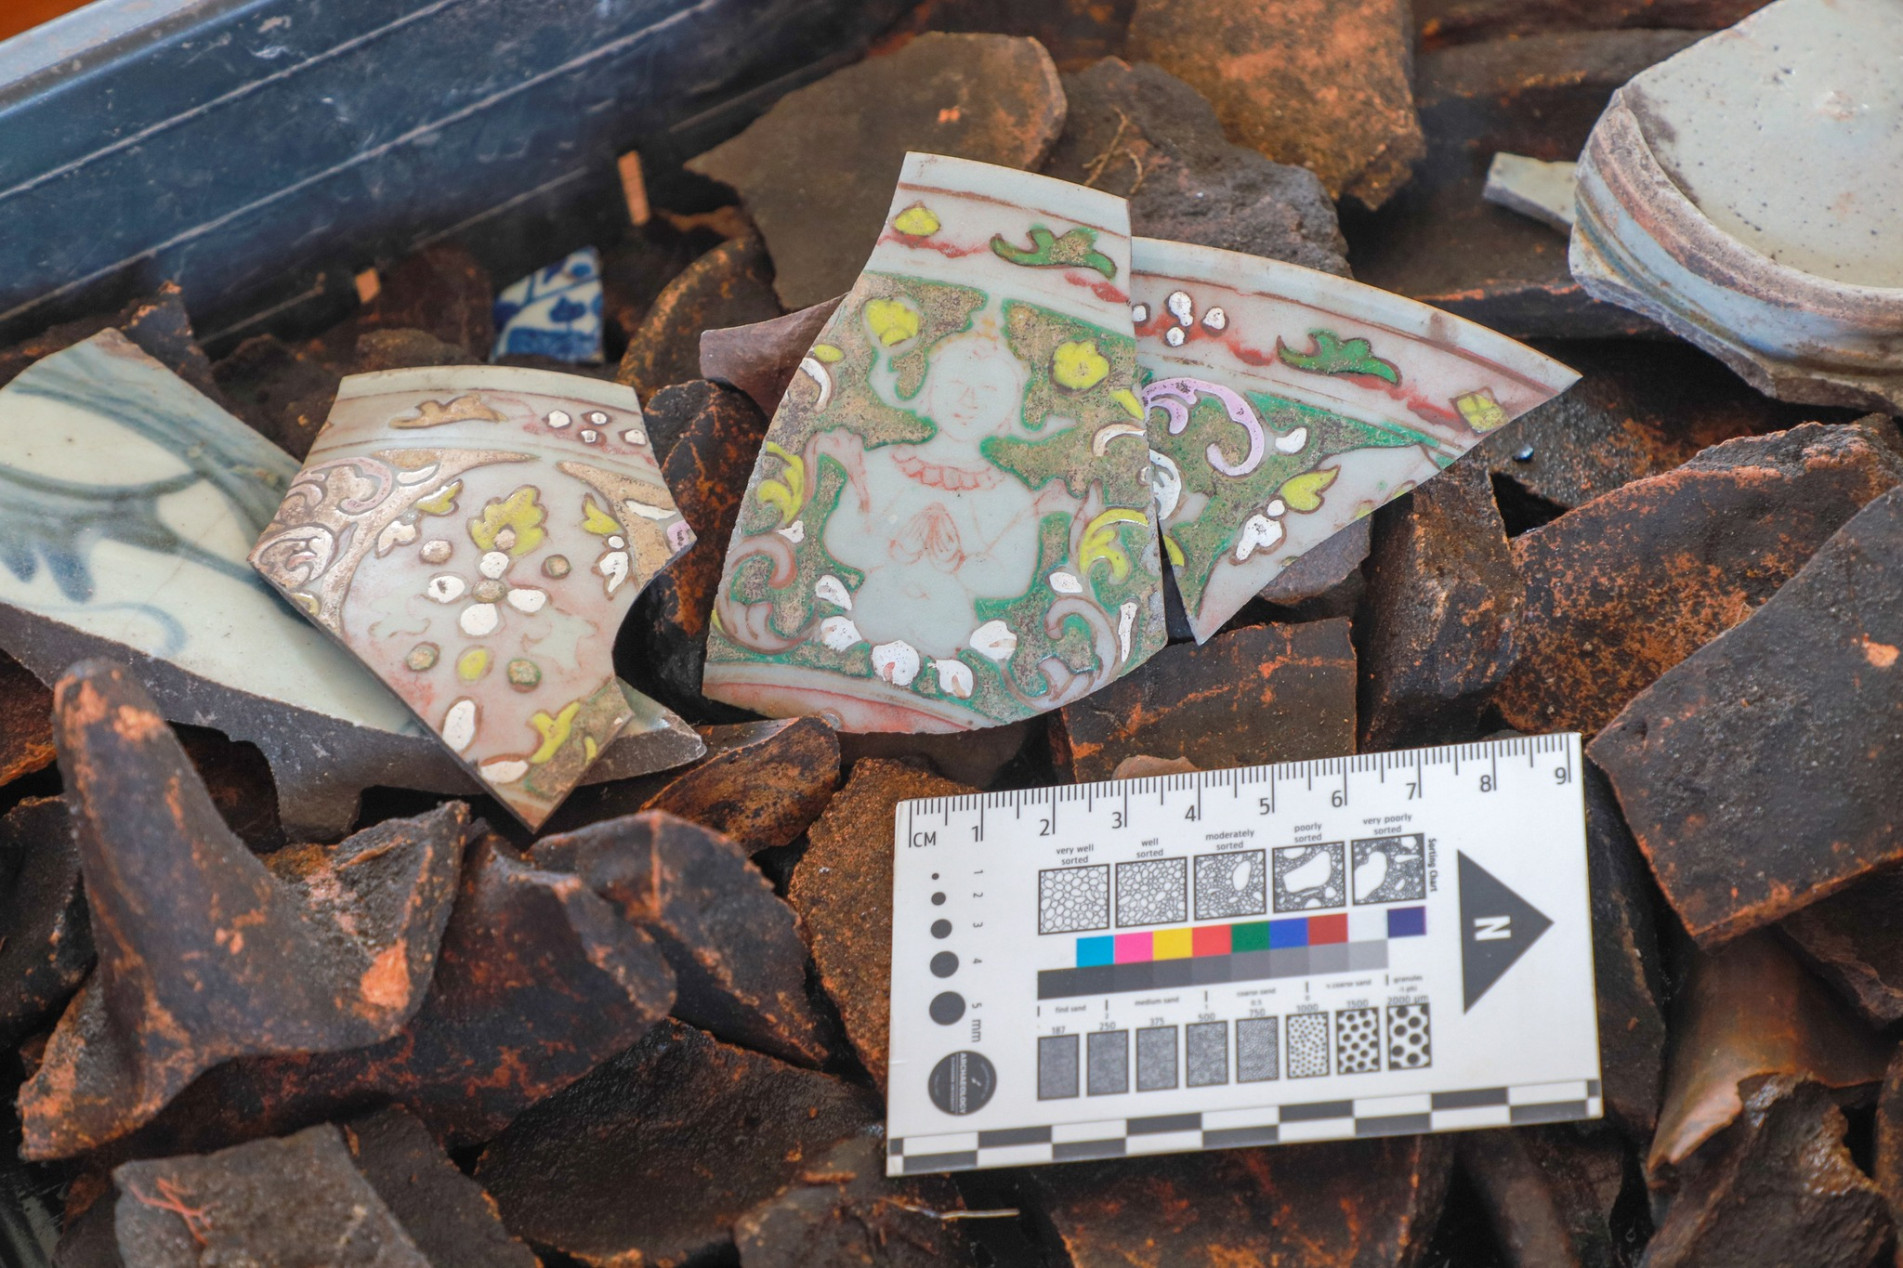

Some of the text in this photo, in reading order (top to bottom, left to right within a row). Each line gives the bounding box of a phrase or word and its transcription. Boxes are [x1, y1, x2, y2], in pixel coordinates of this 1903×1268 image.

[913, 767, 1567, 848] CM 1 2 3 4 5 6 7 8 9
[1363, 813, 1412, 826] very poorly
[1294, 822, 1322, 833] poorly
[1373, 825, 1402, 835] sorted
[1205, 829, 1255, 841] moderately
[1294, 833, 1322, 843] sorted
[1141, 838, 1159, 847] well
[1216, 841, 1244, 851] sorted
[1056, 844, 1094, 855] very well
[1136, 849, 1164, 859] sorted
[1061, 856, 1089, 865] sorted
[1428, 838, 1438, 892] Sorting Chart
[1473, 915, 1511, 941] N
[1346, 999, 1369, 1008] 1500
[1387, 995, 1411, 1005] 2000
[1249, 1008, 1266, 1017] 750
[1296, 1003, 1319, 1013] 1000
[1150, 1017, 1165, 1026] 375
[1198, 1012, 1215, 1021] 500
[971, 1019, 981, 1043] mm
[1051, 1026, 1066, 1035] 187
[1100, 1021, 1116, 1031] 250
